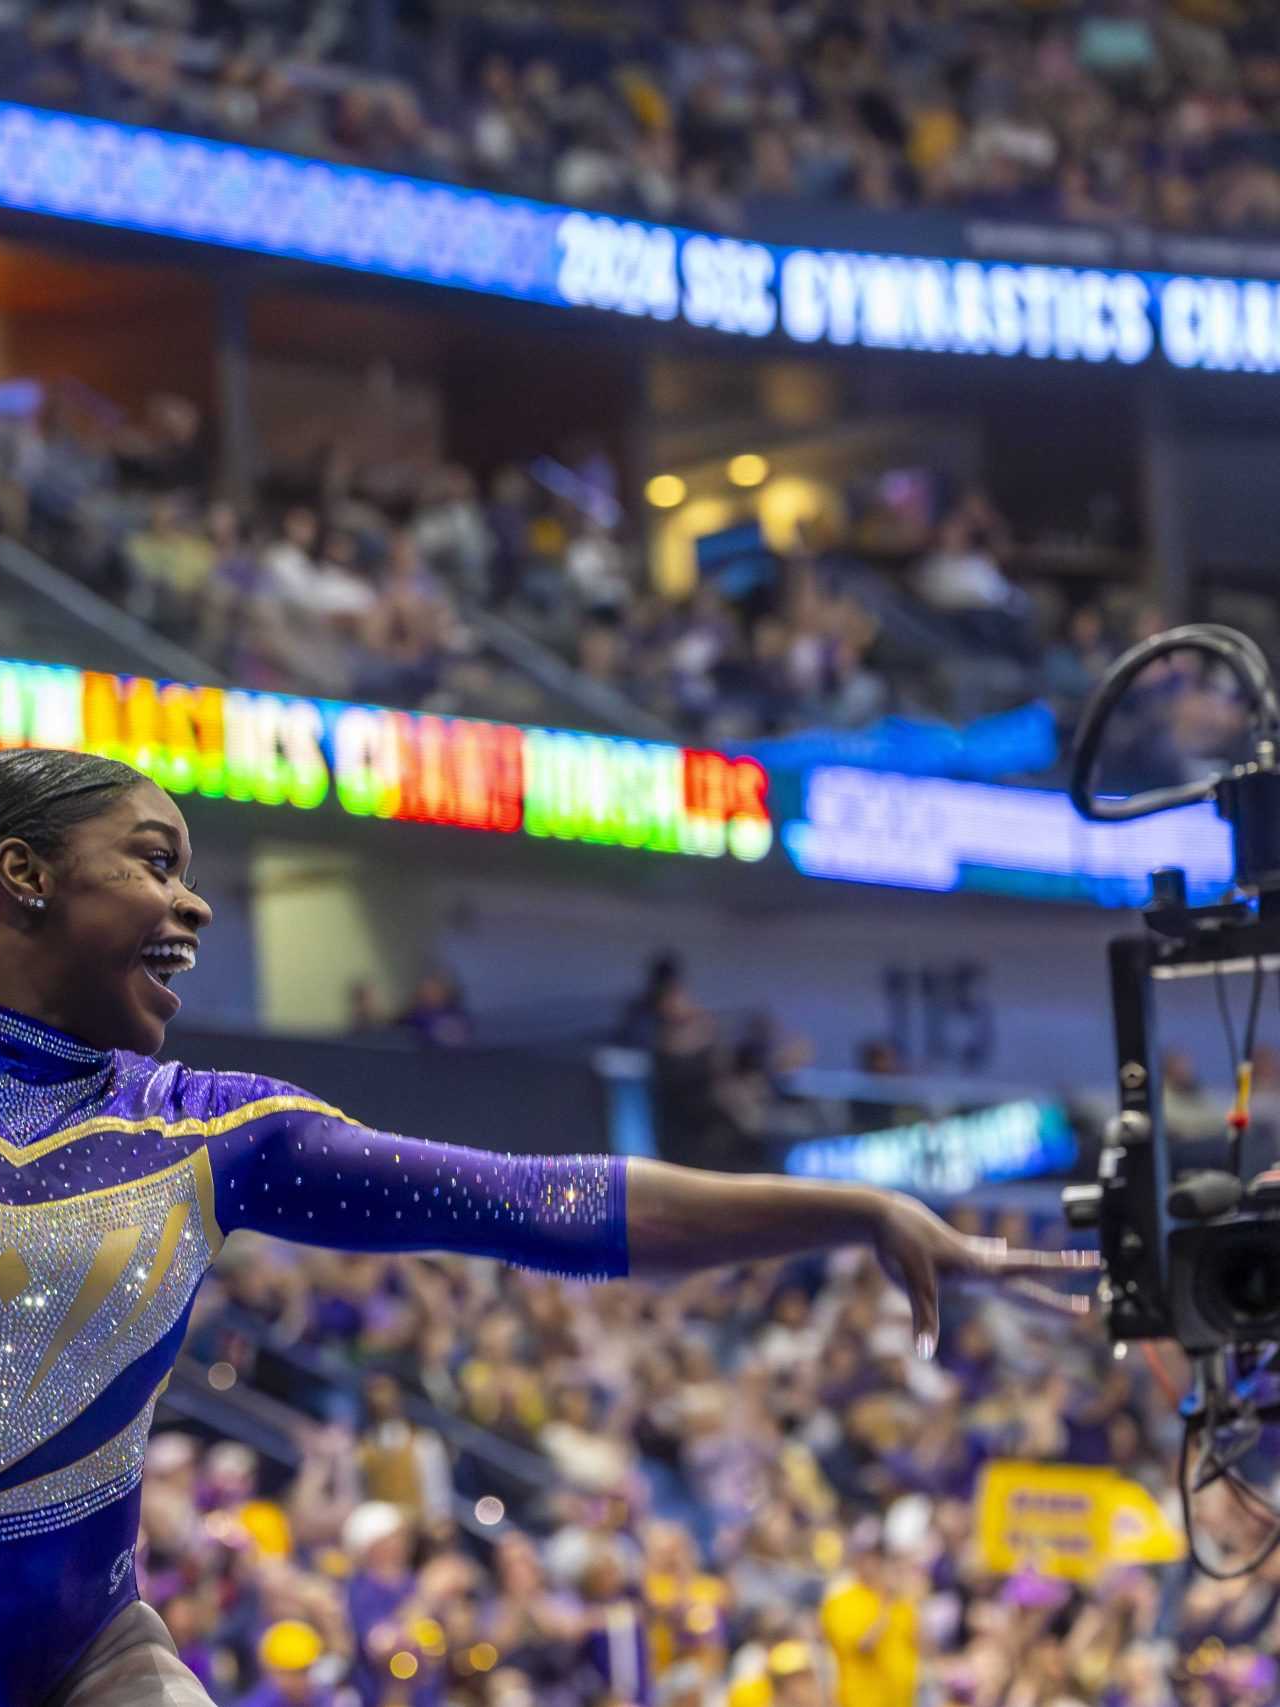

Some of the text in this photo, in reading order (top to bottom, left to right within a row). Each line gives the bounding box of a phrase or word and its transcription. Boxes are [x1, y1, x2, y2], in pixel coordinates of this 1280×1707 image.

[558, 212, 678, 321] 2024
[683, 234, 776, 336] SEC
[782, 249, 1152, 365] GYMNASTICS
